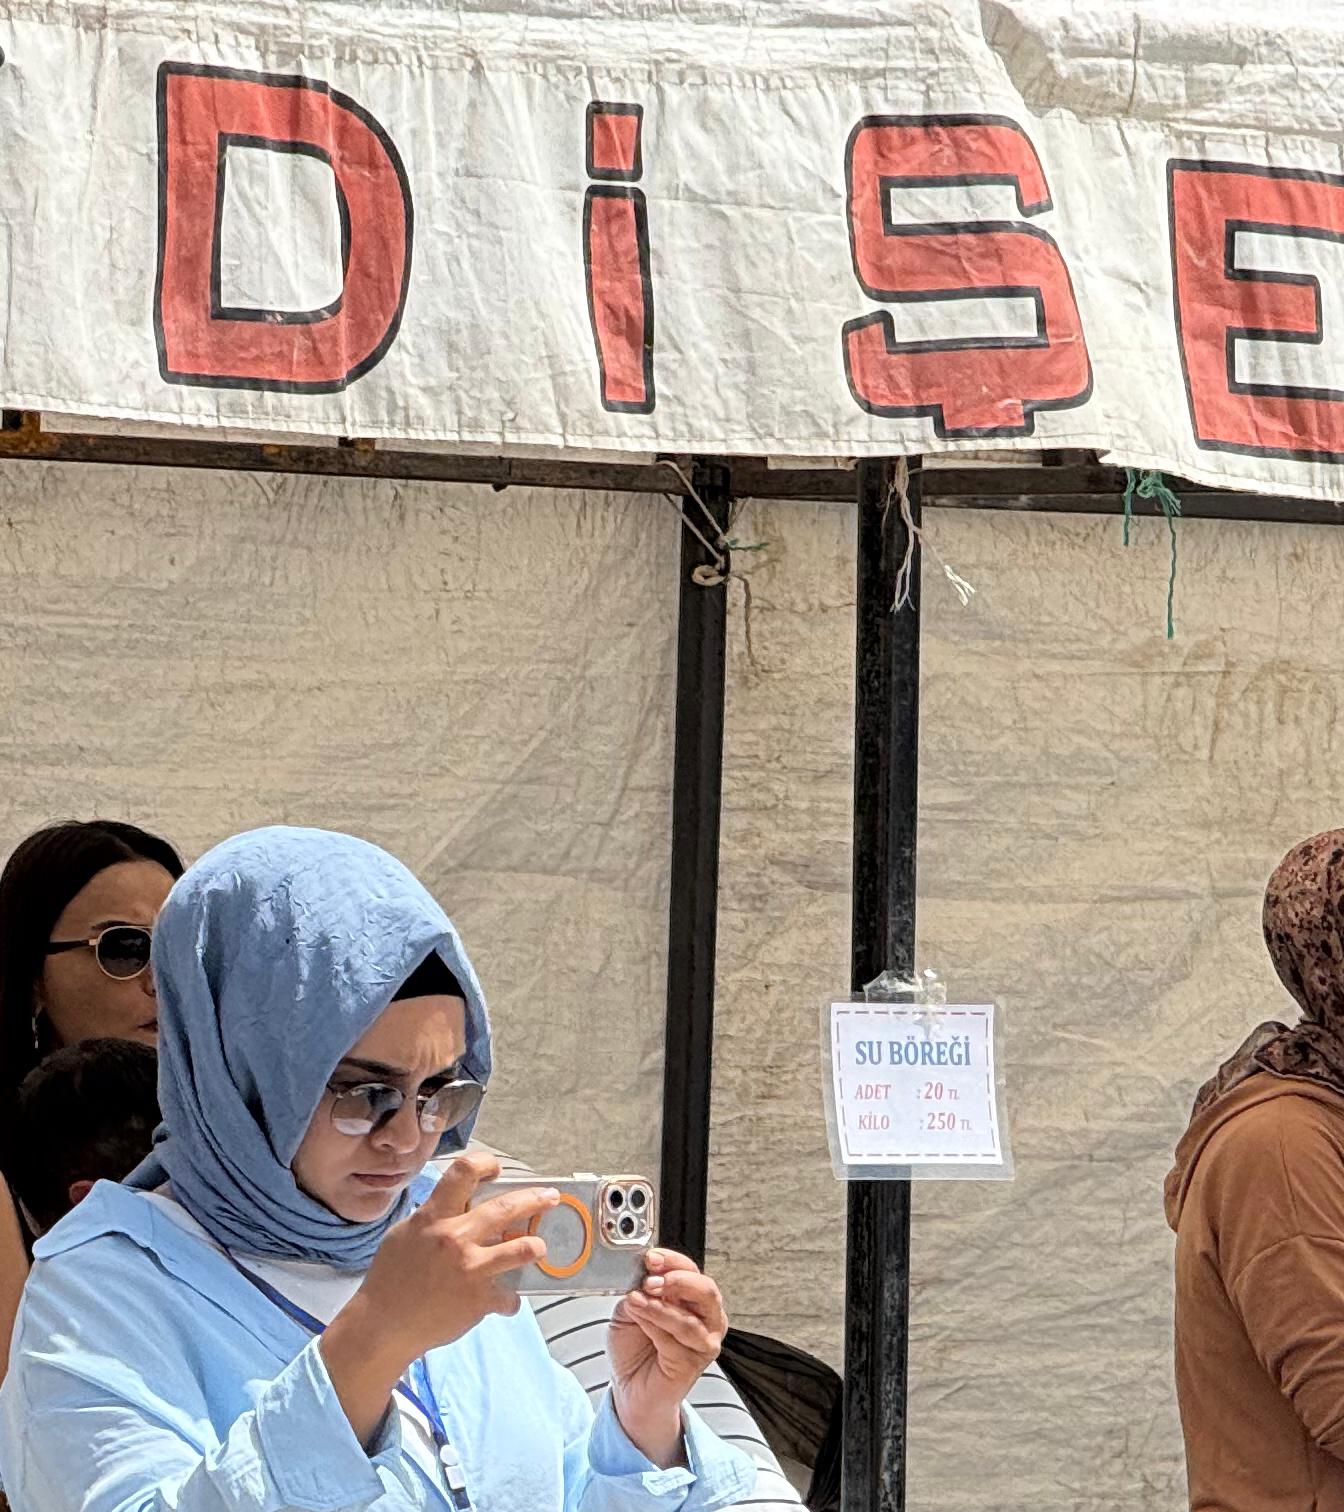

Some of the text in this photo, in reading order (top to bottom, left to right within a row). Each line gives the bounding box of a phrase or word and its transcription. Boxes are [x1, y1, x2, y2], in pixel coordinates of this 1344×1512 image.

[855, 1035, 971, 1066] SU BÖREĞİ
[854, 1083, 891, 1100] ADET
[858, 1111, 890, 1130] KİLO
